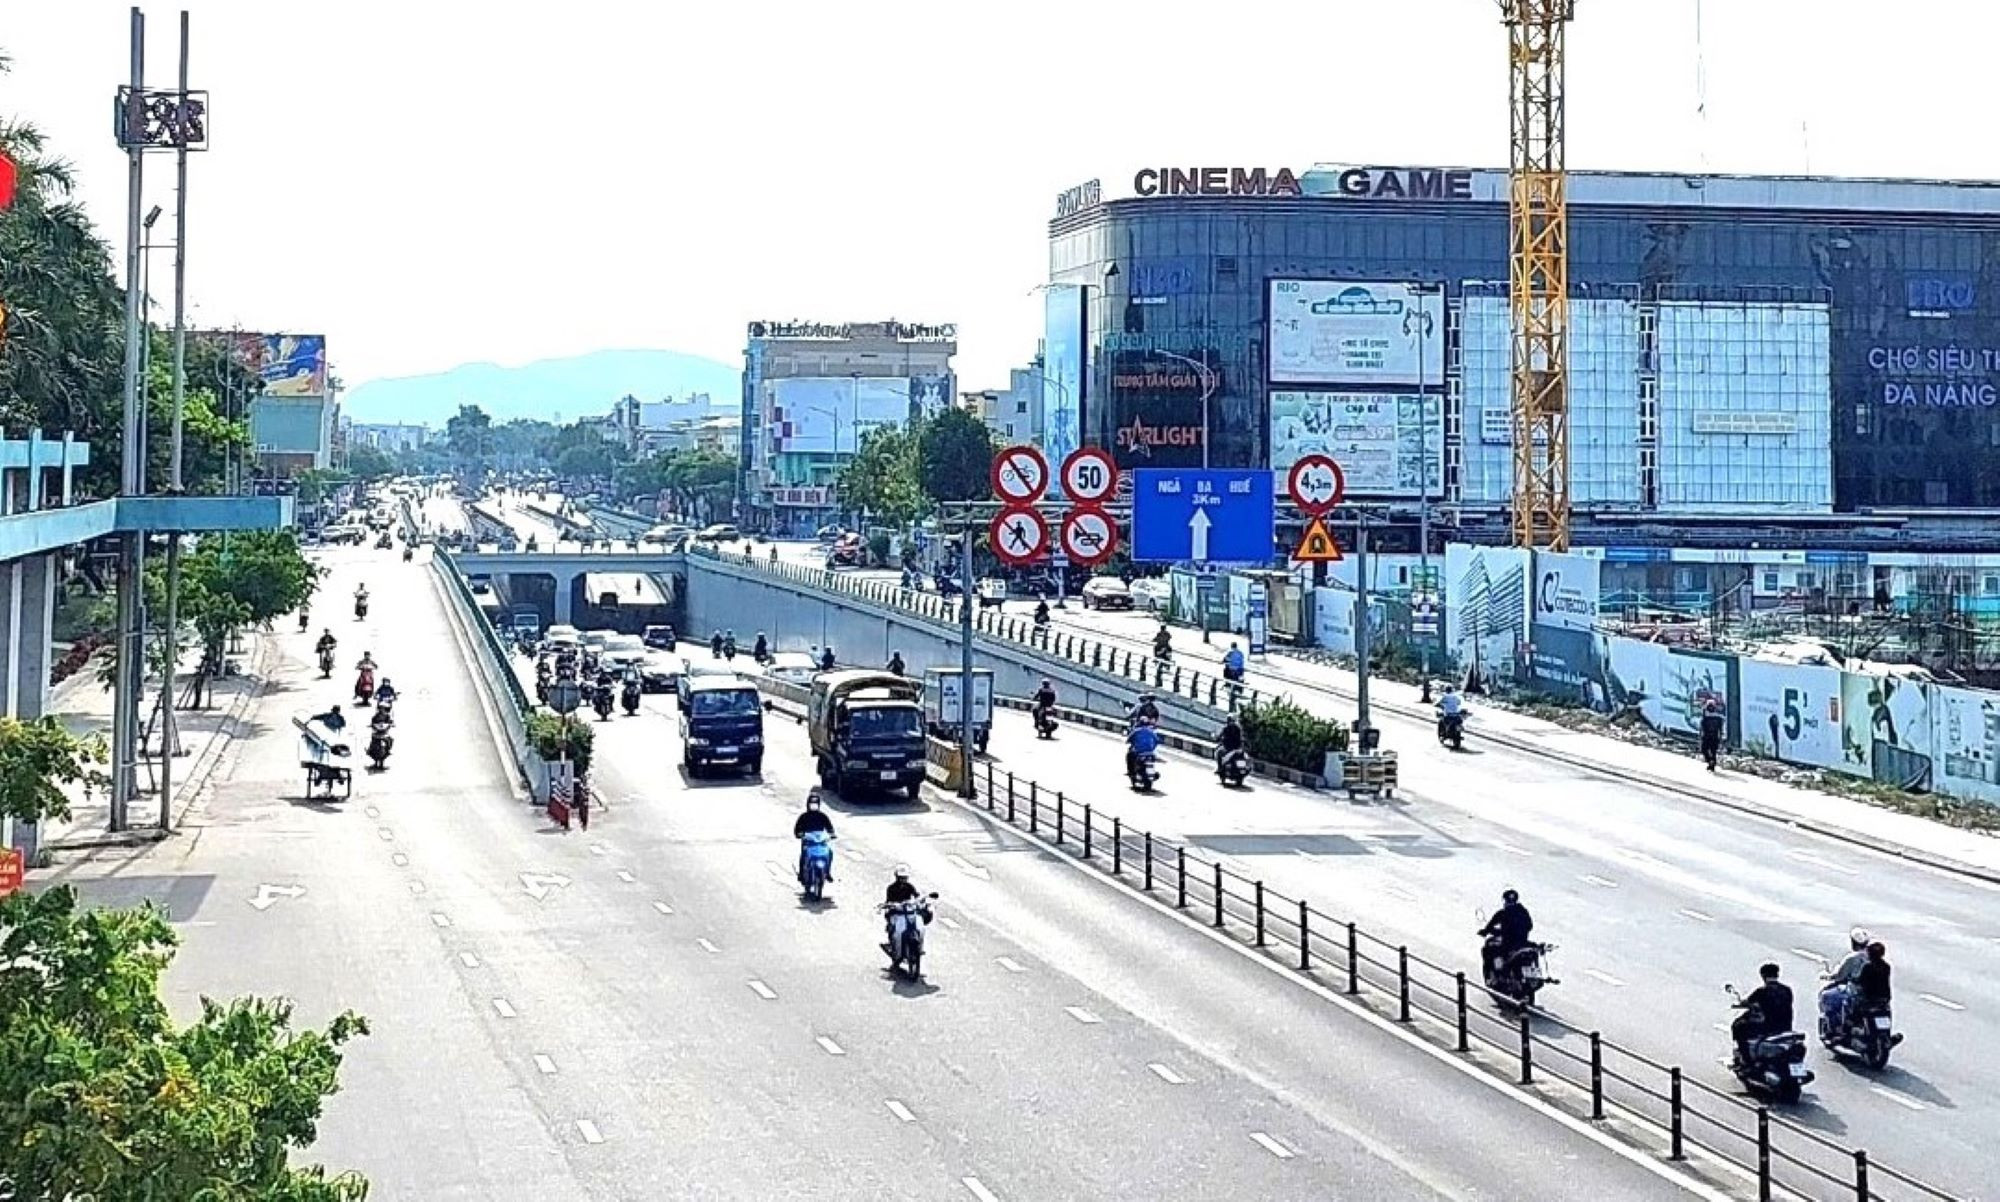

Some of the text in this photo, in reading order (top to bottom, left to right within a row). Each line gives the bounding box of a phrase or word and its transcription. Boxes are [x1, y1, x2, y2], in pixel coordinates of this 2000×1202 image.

[1134, 167, 1472, 199] CINEMA GAME
[1926, 343, 1975, 370] SIÊU
[1884, 377, 1917, 405] ĐÀ
[1117, 421, 1208, 450] STARLIGHT
[1078, 465, 1101, 490] 50
[1158, 476, 1182, 493] NGÃ
[1197, 480, 1212, 493] BA
[1301, 472, 1332, 492] 4,3m
